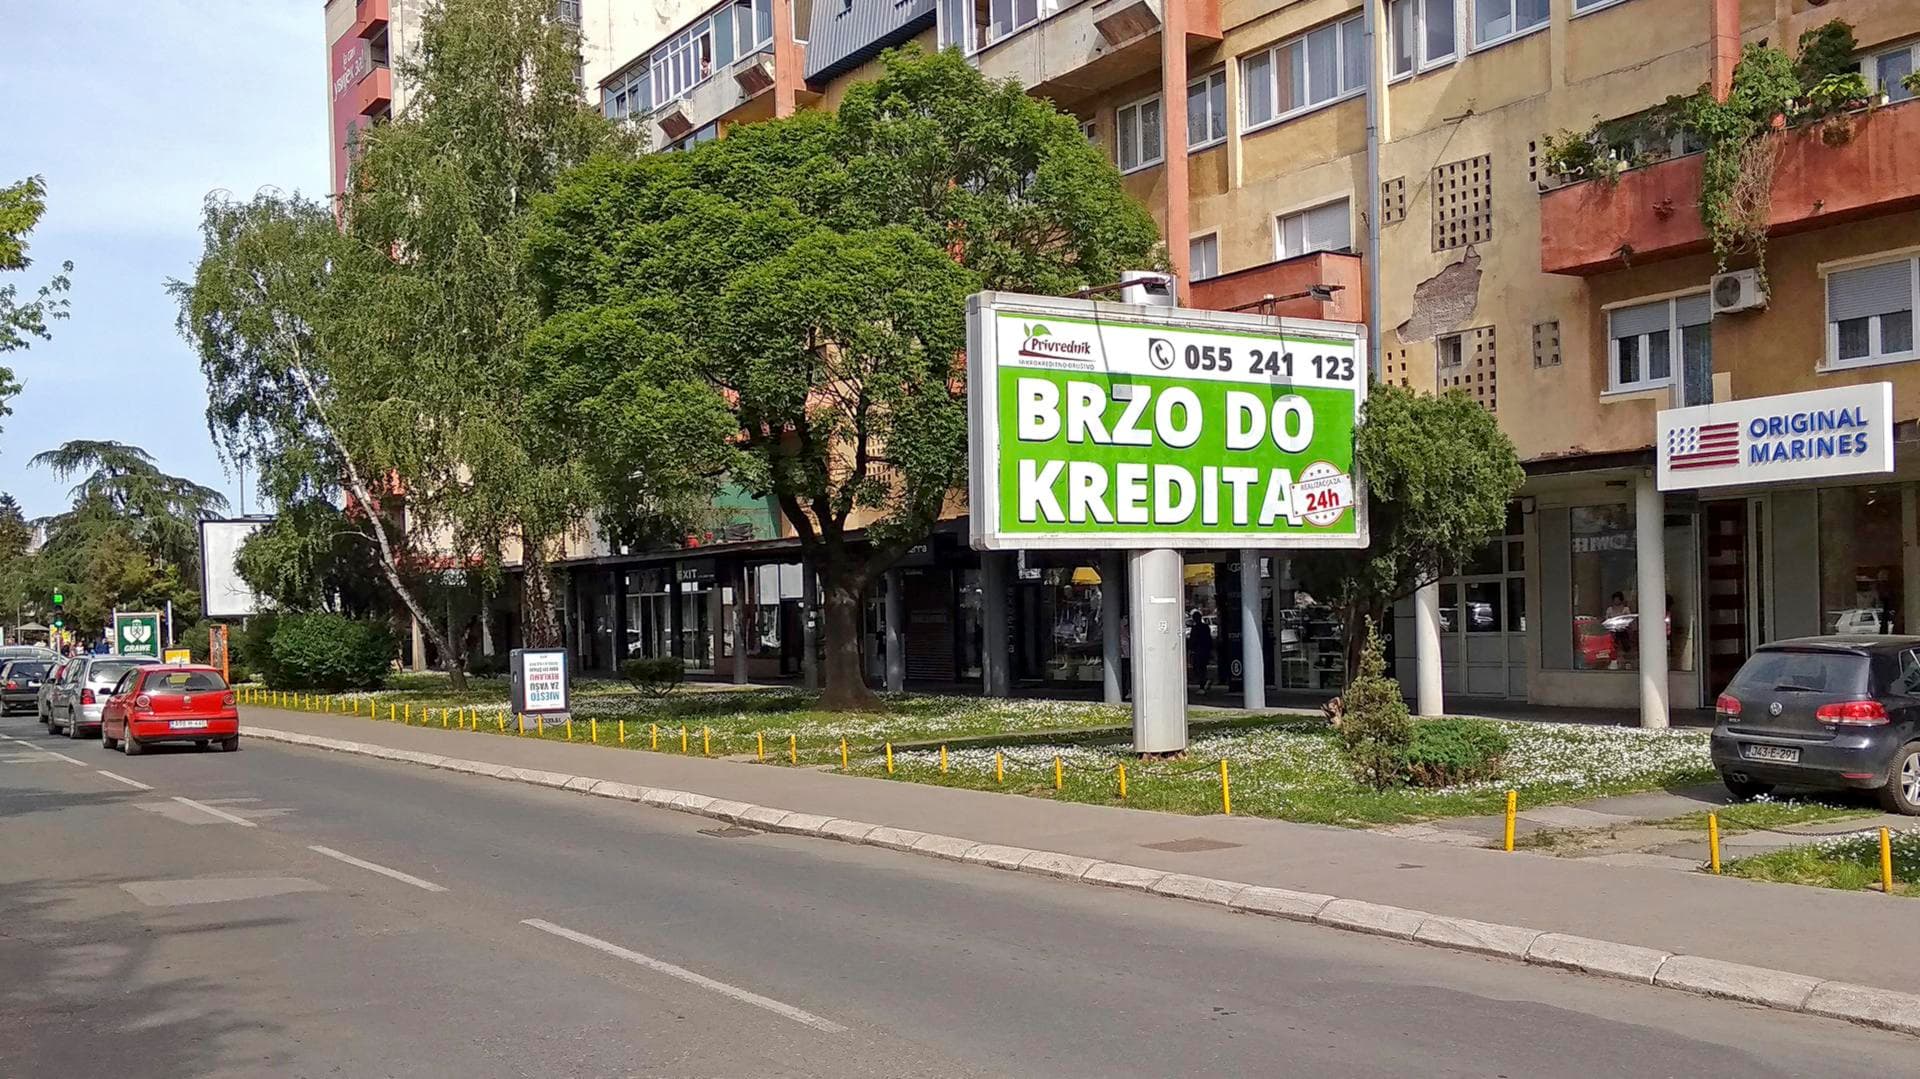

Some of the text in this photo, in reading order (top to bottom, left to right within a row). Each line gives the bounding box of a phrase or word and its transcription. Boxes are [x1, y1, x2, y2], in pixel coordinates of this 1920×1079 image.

[1031, 338, 1091, 354] Privrednik
[1185, 344, 1355, 381] 055 241 123
[1017, 377, 1315, 453] BRZO DO
[1749, 406, 1869, 438] ORIGINAL
[1749, 431, 1868, 463] MARINES
[1018, 459, 1304, 527] KREDITA
[1306, 488, 1339, 512] 24h
[124, 644, 151, 652] GRAWE
[530, 682, 559, 692] ZA VAŠU
[531, 691, 560, 701] MJESTO
